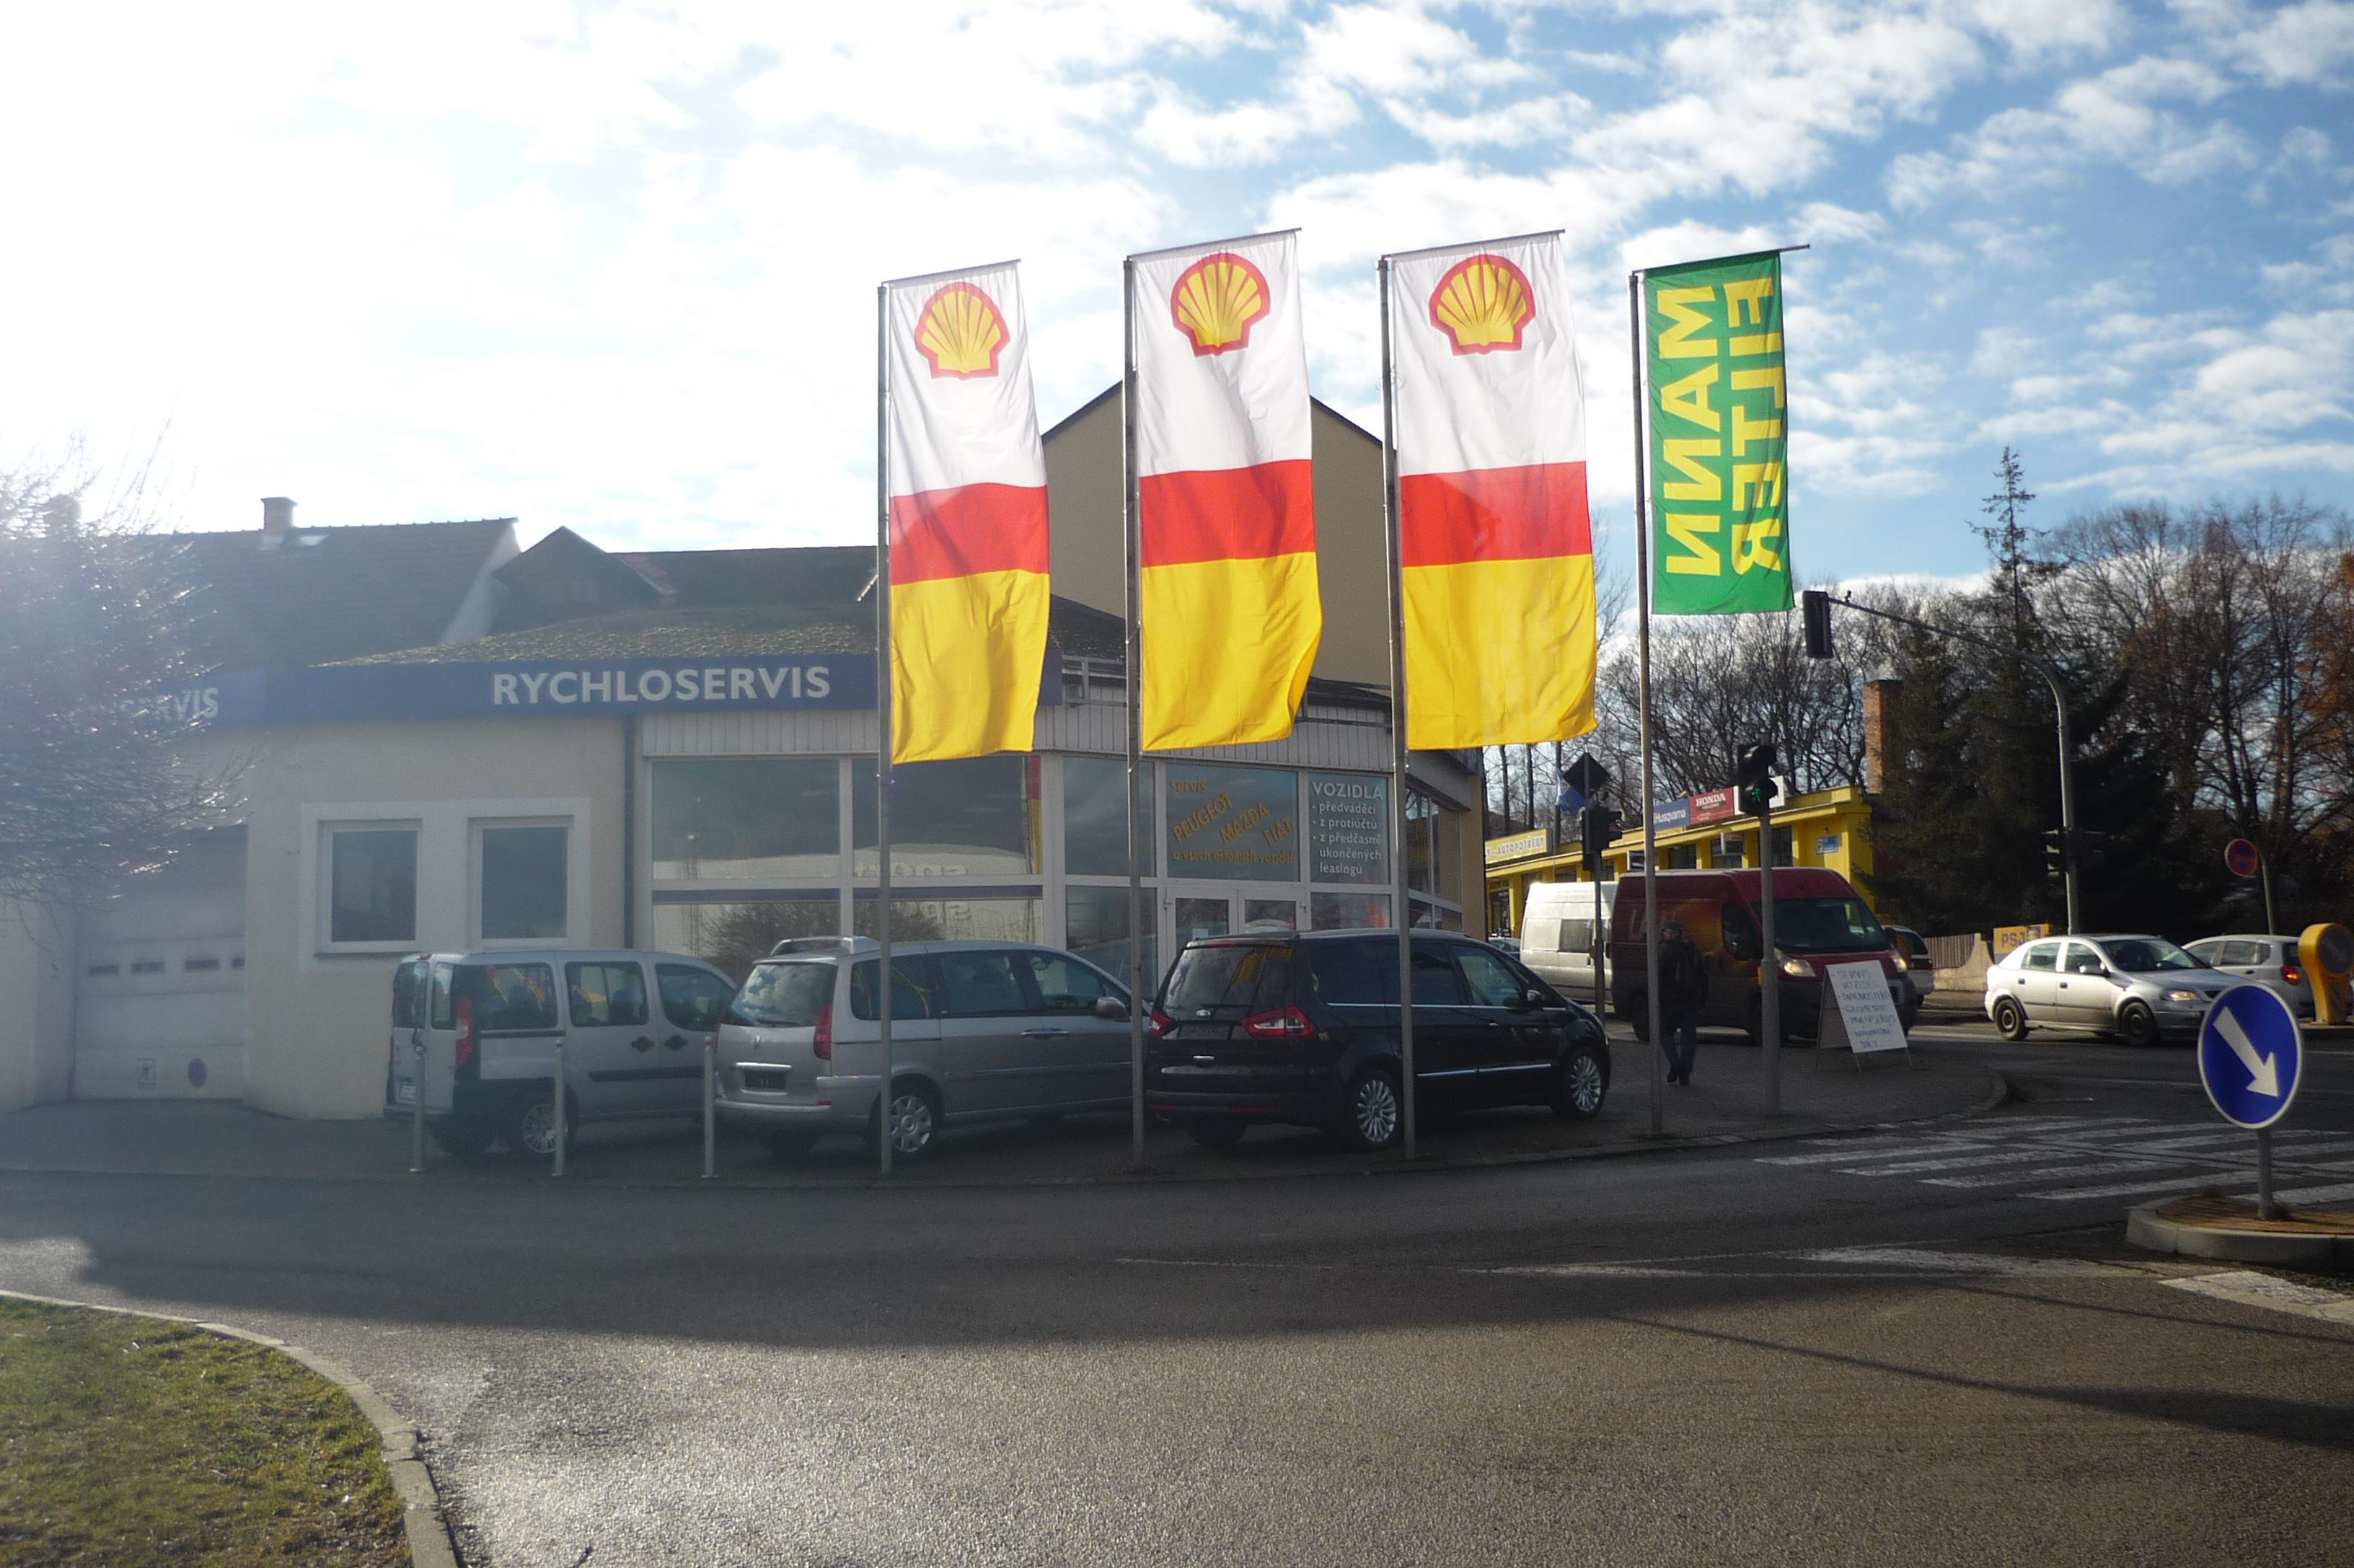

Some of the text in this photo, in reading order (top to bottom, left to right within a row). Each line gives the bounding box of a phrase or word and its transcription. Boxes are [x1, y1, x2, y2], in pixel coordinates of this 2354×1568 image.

[493, 666, 831, 705] RYCHLOSERVIS
[1171, 777, 1207, 793] servis
[1312, 781, 1383, 800] VOZIDLA
[1696, 793, 1726, 807] HONDA
[1173, 791, 1233, 842] PEUGEOT
[1219, 801, 1270, 843] MAZDA
[1263, 815, 1293, 846] FIAT
[1319, 847, 1381, 862] ukončených
